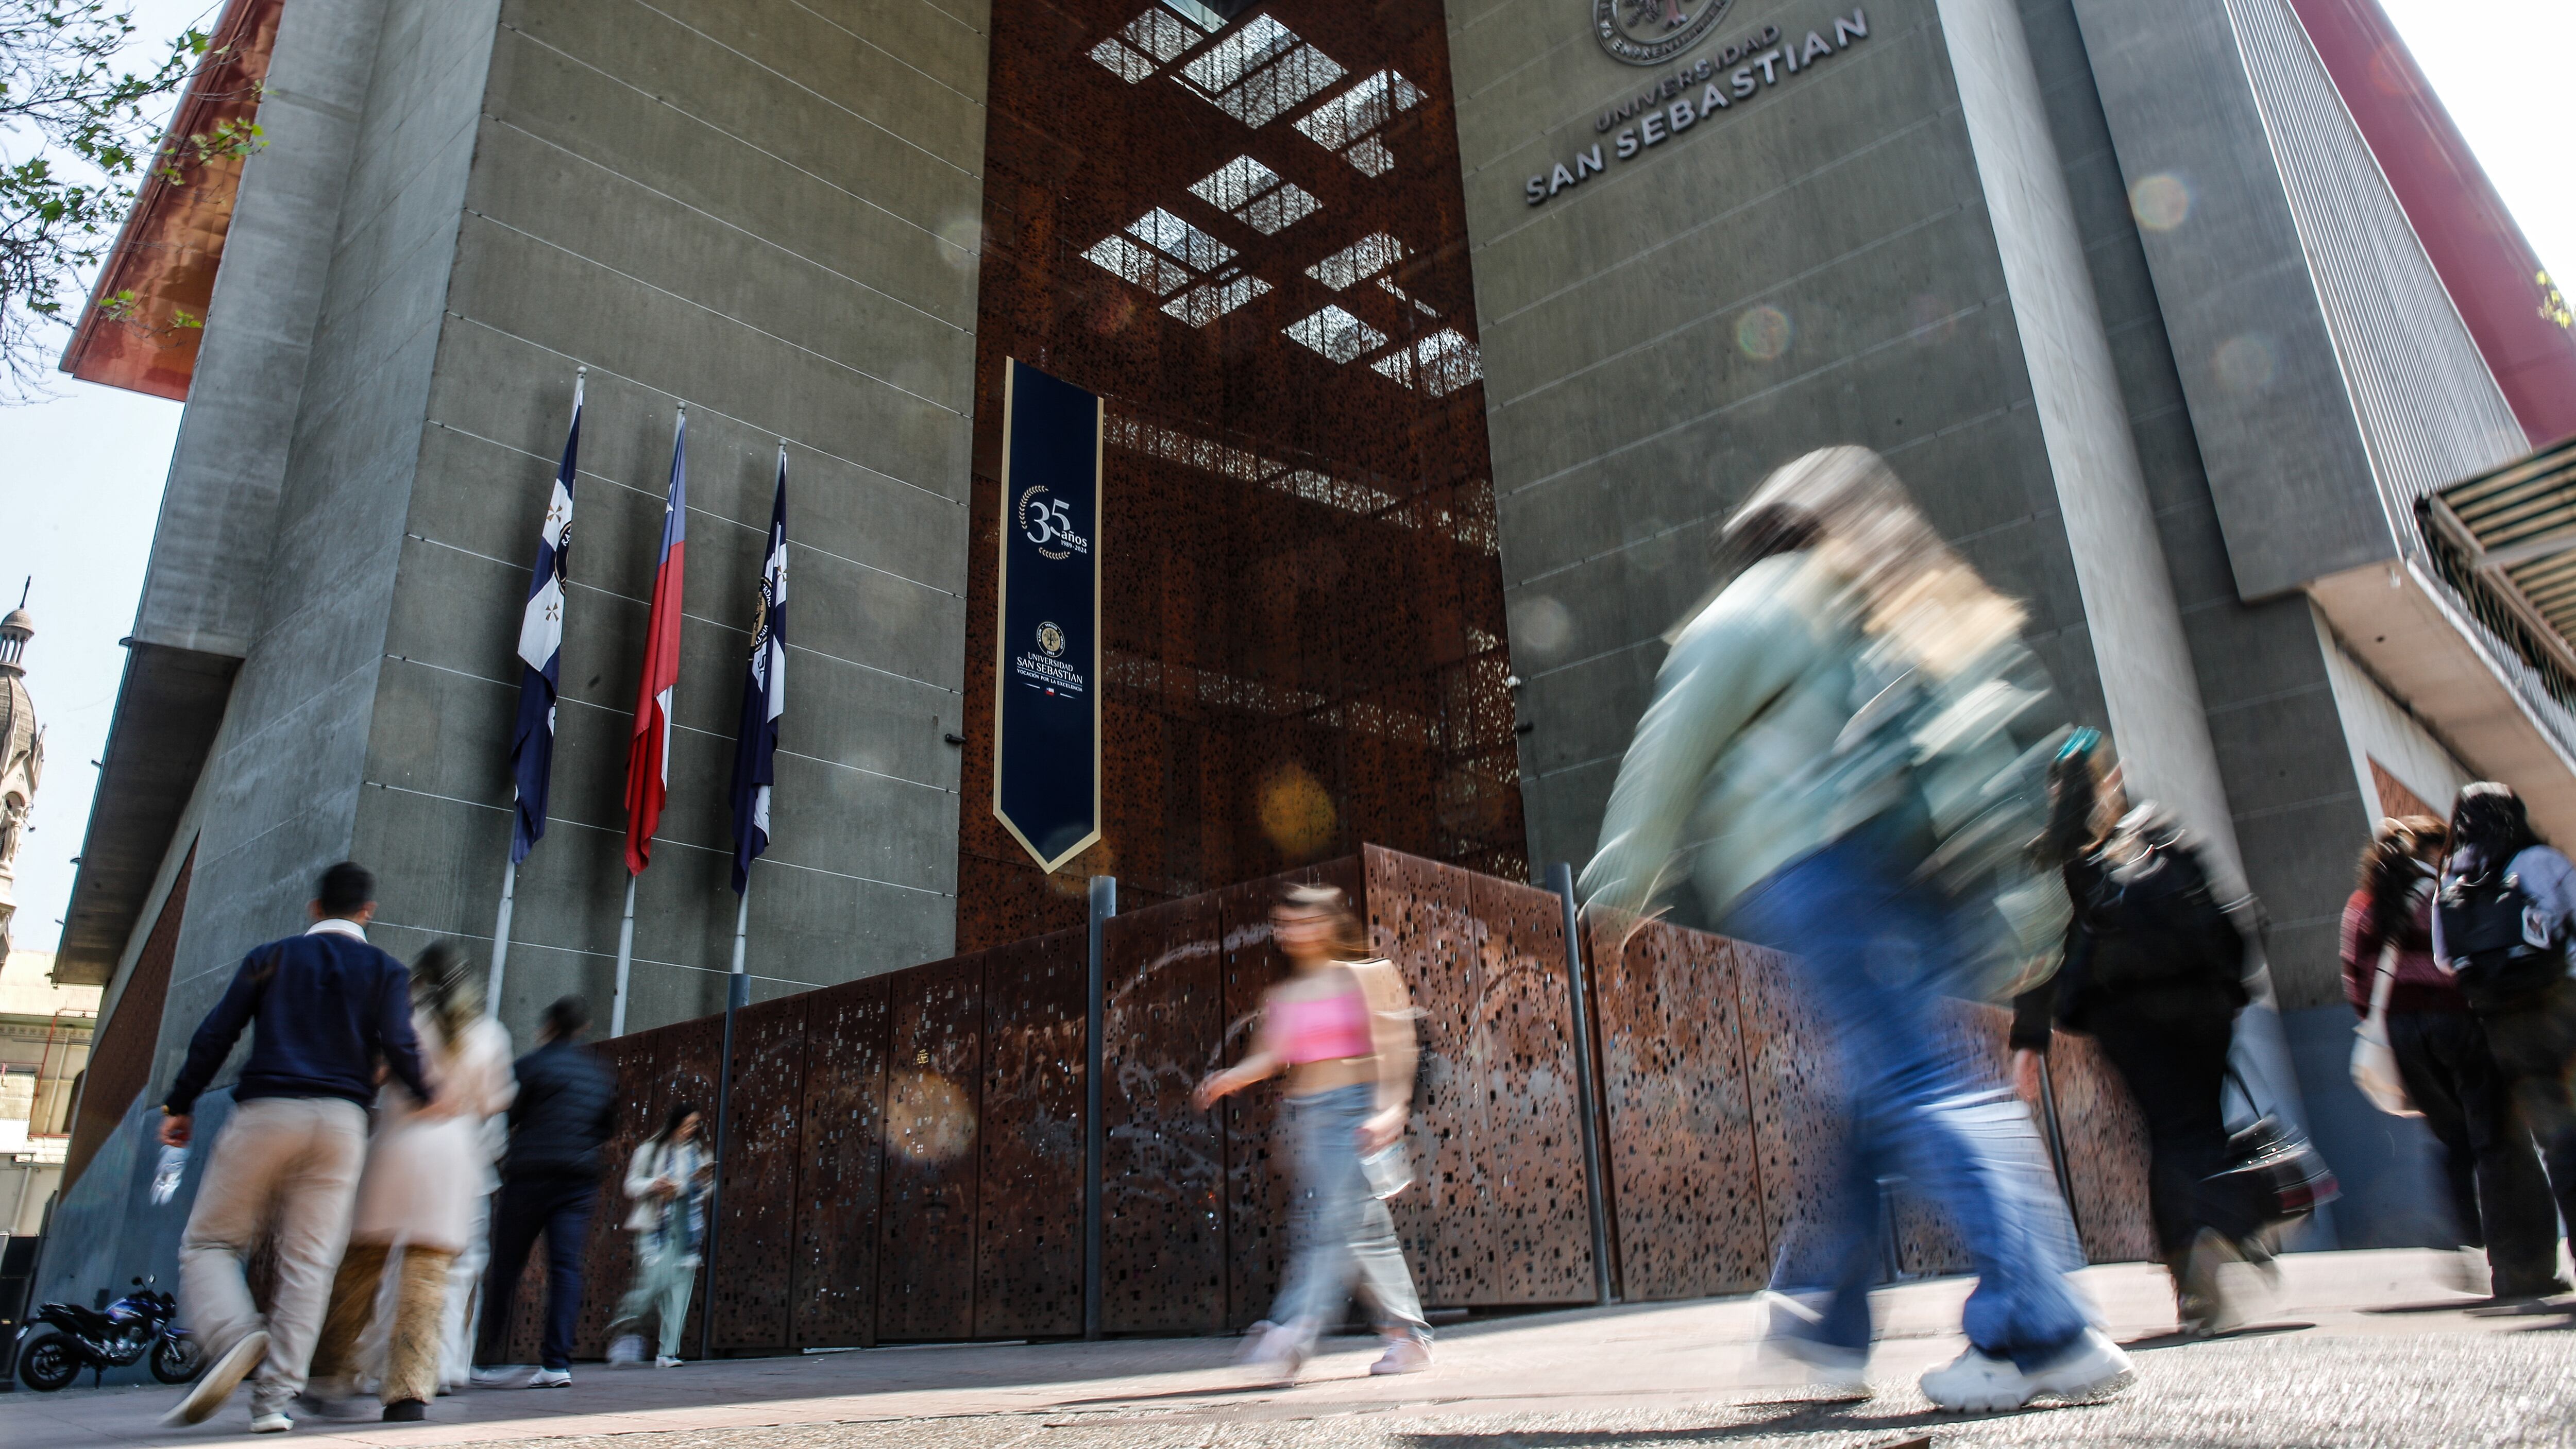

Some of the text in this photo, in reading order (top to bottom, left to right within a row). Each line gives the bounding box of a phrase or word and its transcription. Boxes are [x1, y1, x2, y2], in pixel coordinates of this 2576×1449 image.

[1595, 24, 1781, 133] UNIVERSIDAD
[1525, 143, 1605, 205] SAN
[1616, 8, 1870, 159] SEBASTIAN
[1027, 498, 1071, 543] 35
[1061, 530, 1087, 547] años
[1017, 656, 1082, 684] SAN SEBASTIAN
[1028, 652, 1073, 672] UNIVERSIDAD
[1017, 669, 1039, 679] VOCACIÓN
[1057, 680, 1082, 692] EXCELENCIA
